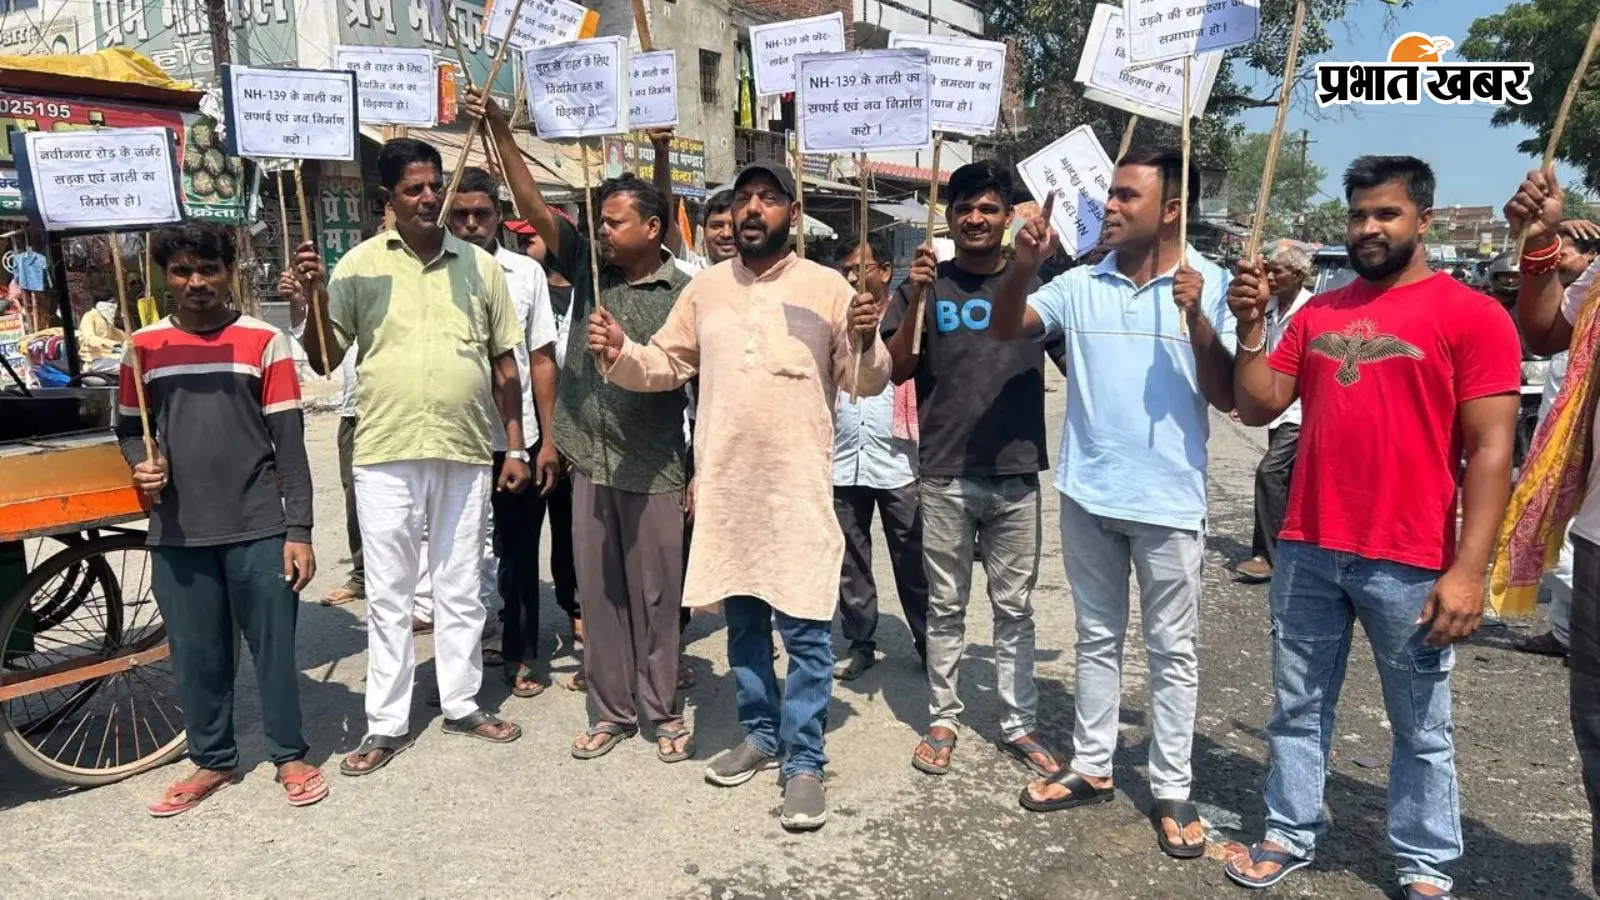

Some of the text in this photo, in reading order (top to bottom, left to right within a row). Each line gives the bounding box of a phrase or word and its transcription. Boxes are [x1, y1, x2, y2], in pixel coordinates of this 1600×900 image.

[1167, 9, 1181, 21] की
[765, 36, 797, 49] NH-139
[363, 60, 372, 71] से
[375, 62, 394, 73] राहत
[396, 62, 405, 71] के
[552, 59, 562, 72] से
[565, 60, 581, 71] राहत
[584, 55, 591, 67] के
[593, 54, 609, 66] लिए
[389, 82, 403, 91] जल
[406, 83, 417, 91] का
[810, 74, 856, 89] NH-139
[861, 73, 871, 86] के
[875, 70, 901, 85] नाली
[906, 73, 920, 84] का
[940, 78, 975, 89] समस्या
[978, 81, 991, 91] का
[546, 80, 604, 95] नियमित जल का
[244, 88, 342, 103] NH-139 के नाली का
[808, 96, 924, 114] सफाई एवं नव निर्माण
[243, 110, 345, 125] सफाई एवं नव निर्माण
[851, 124, 870, 136] करो
[283, 134, 300, 145] करो
[40, 144, 161, 160] नवीनगर रोड के जर्जर
[53, 168, 155, 187] सड़क एवं नाली का
[80, 194, 119, 207] निर्माण
[1062, 200, 1089, 236] NH-139
